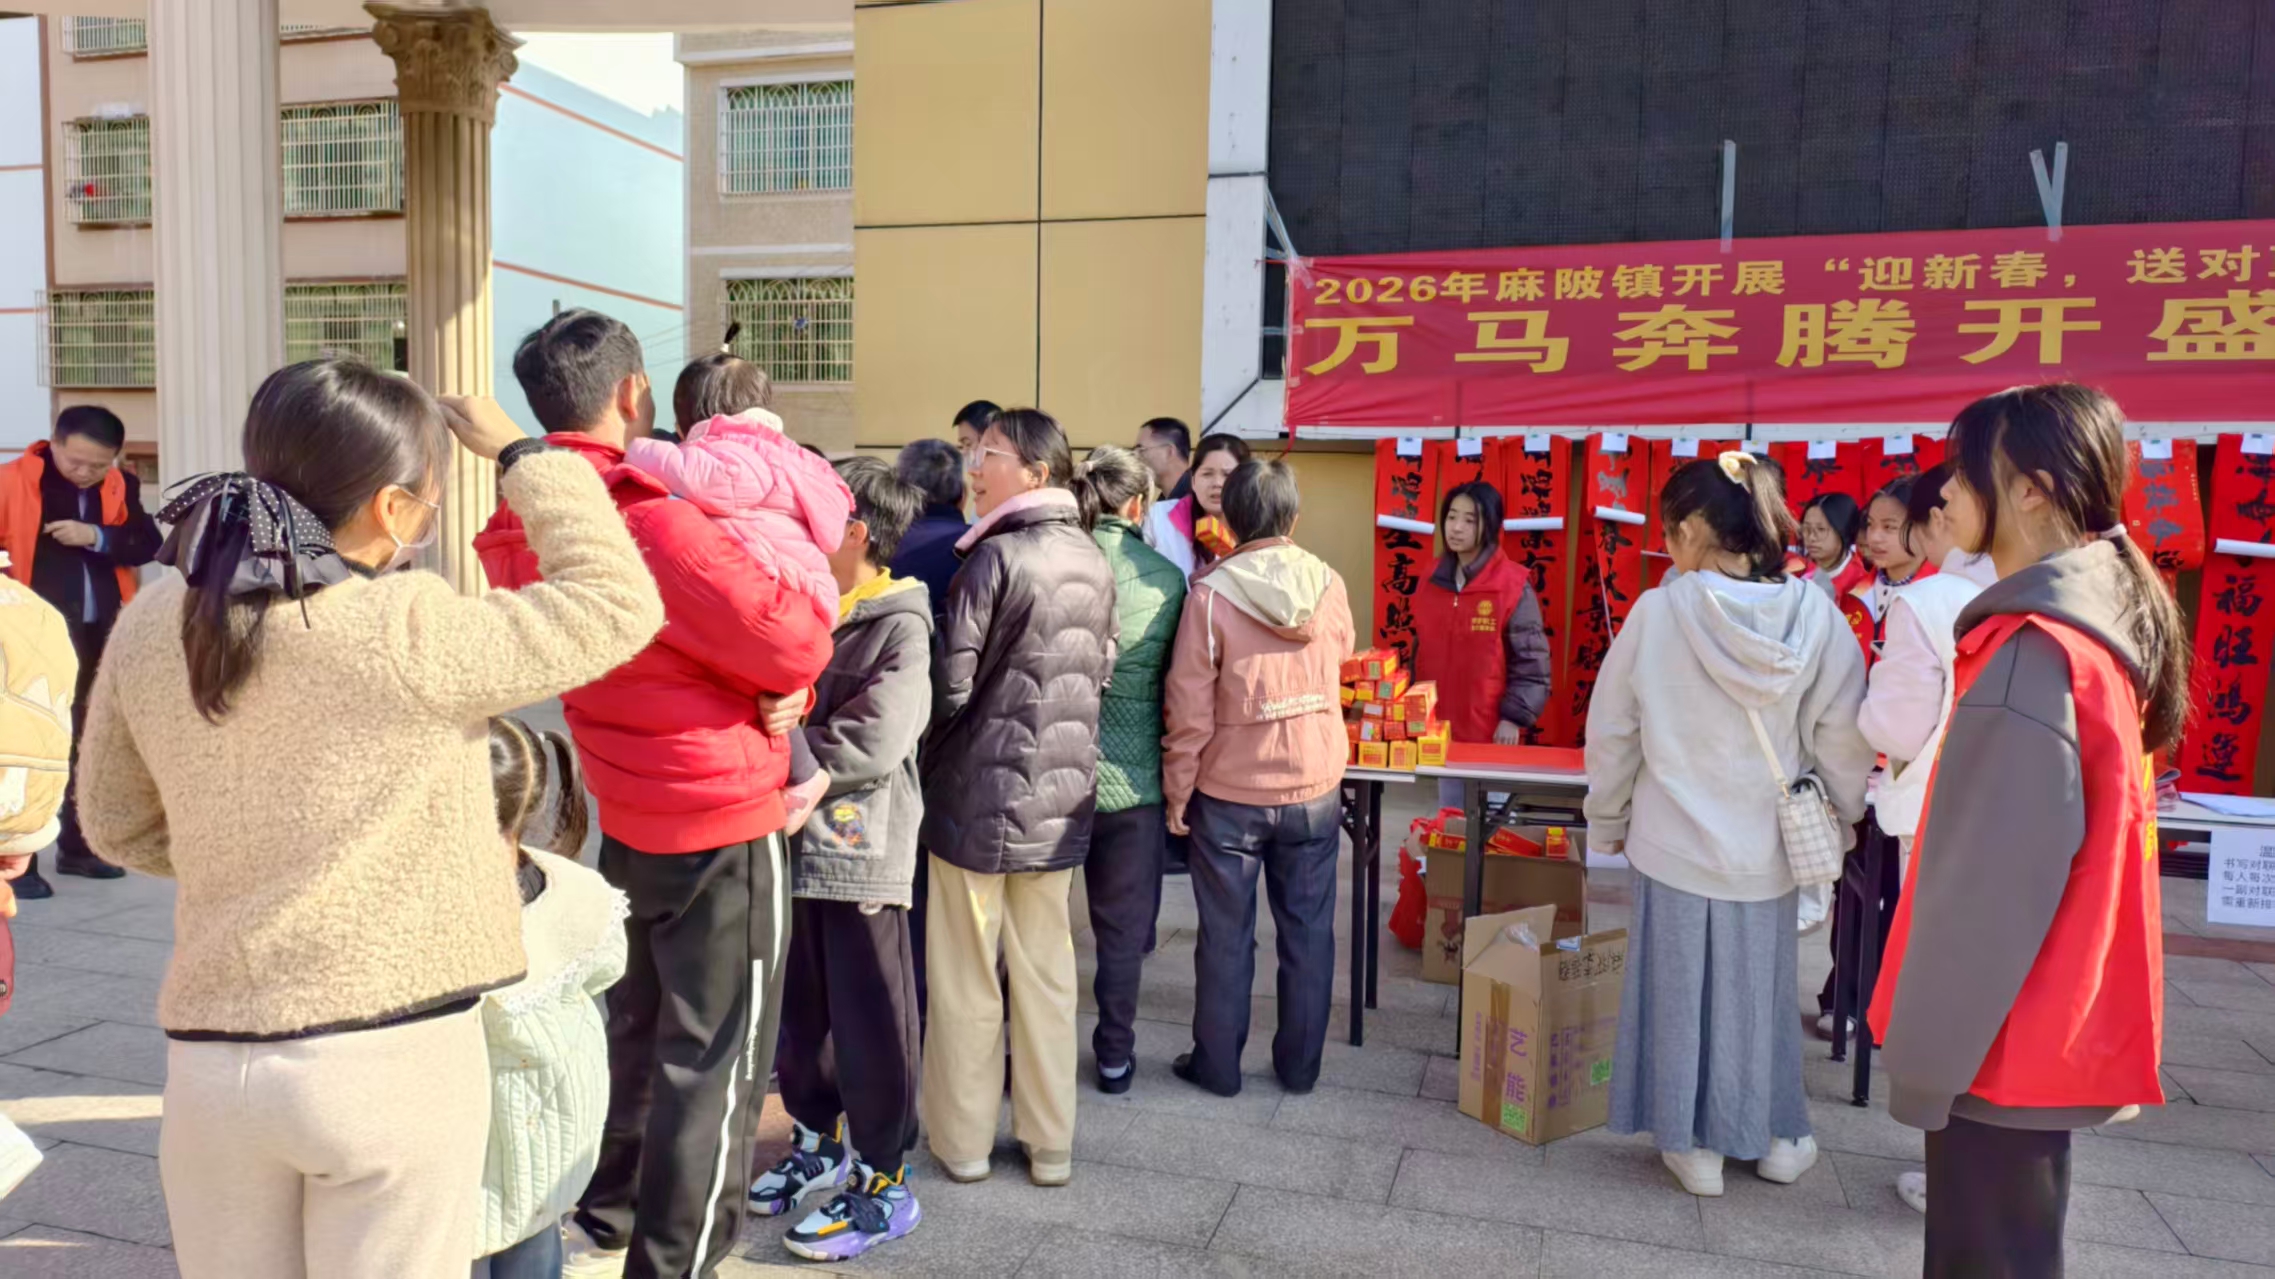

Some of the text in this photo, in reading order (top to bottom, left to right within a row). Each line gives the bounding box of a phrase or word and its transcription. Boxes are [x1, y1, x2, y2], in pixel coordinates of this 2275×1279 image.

[1314, 245, 2275, 305] 2026年麻陂镇开展“迎新春，送对
[1304, 289, 2275, 376] 万马奔腾开盛
